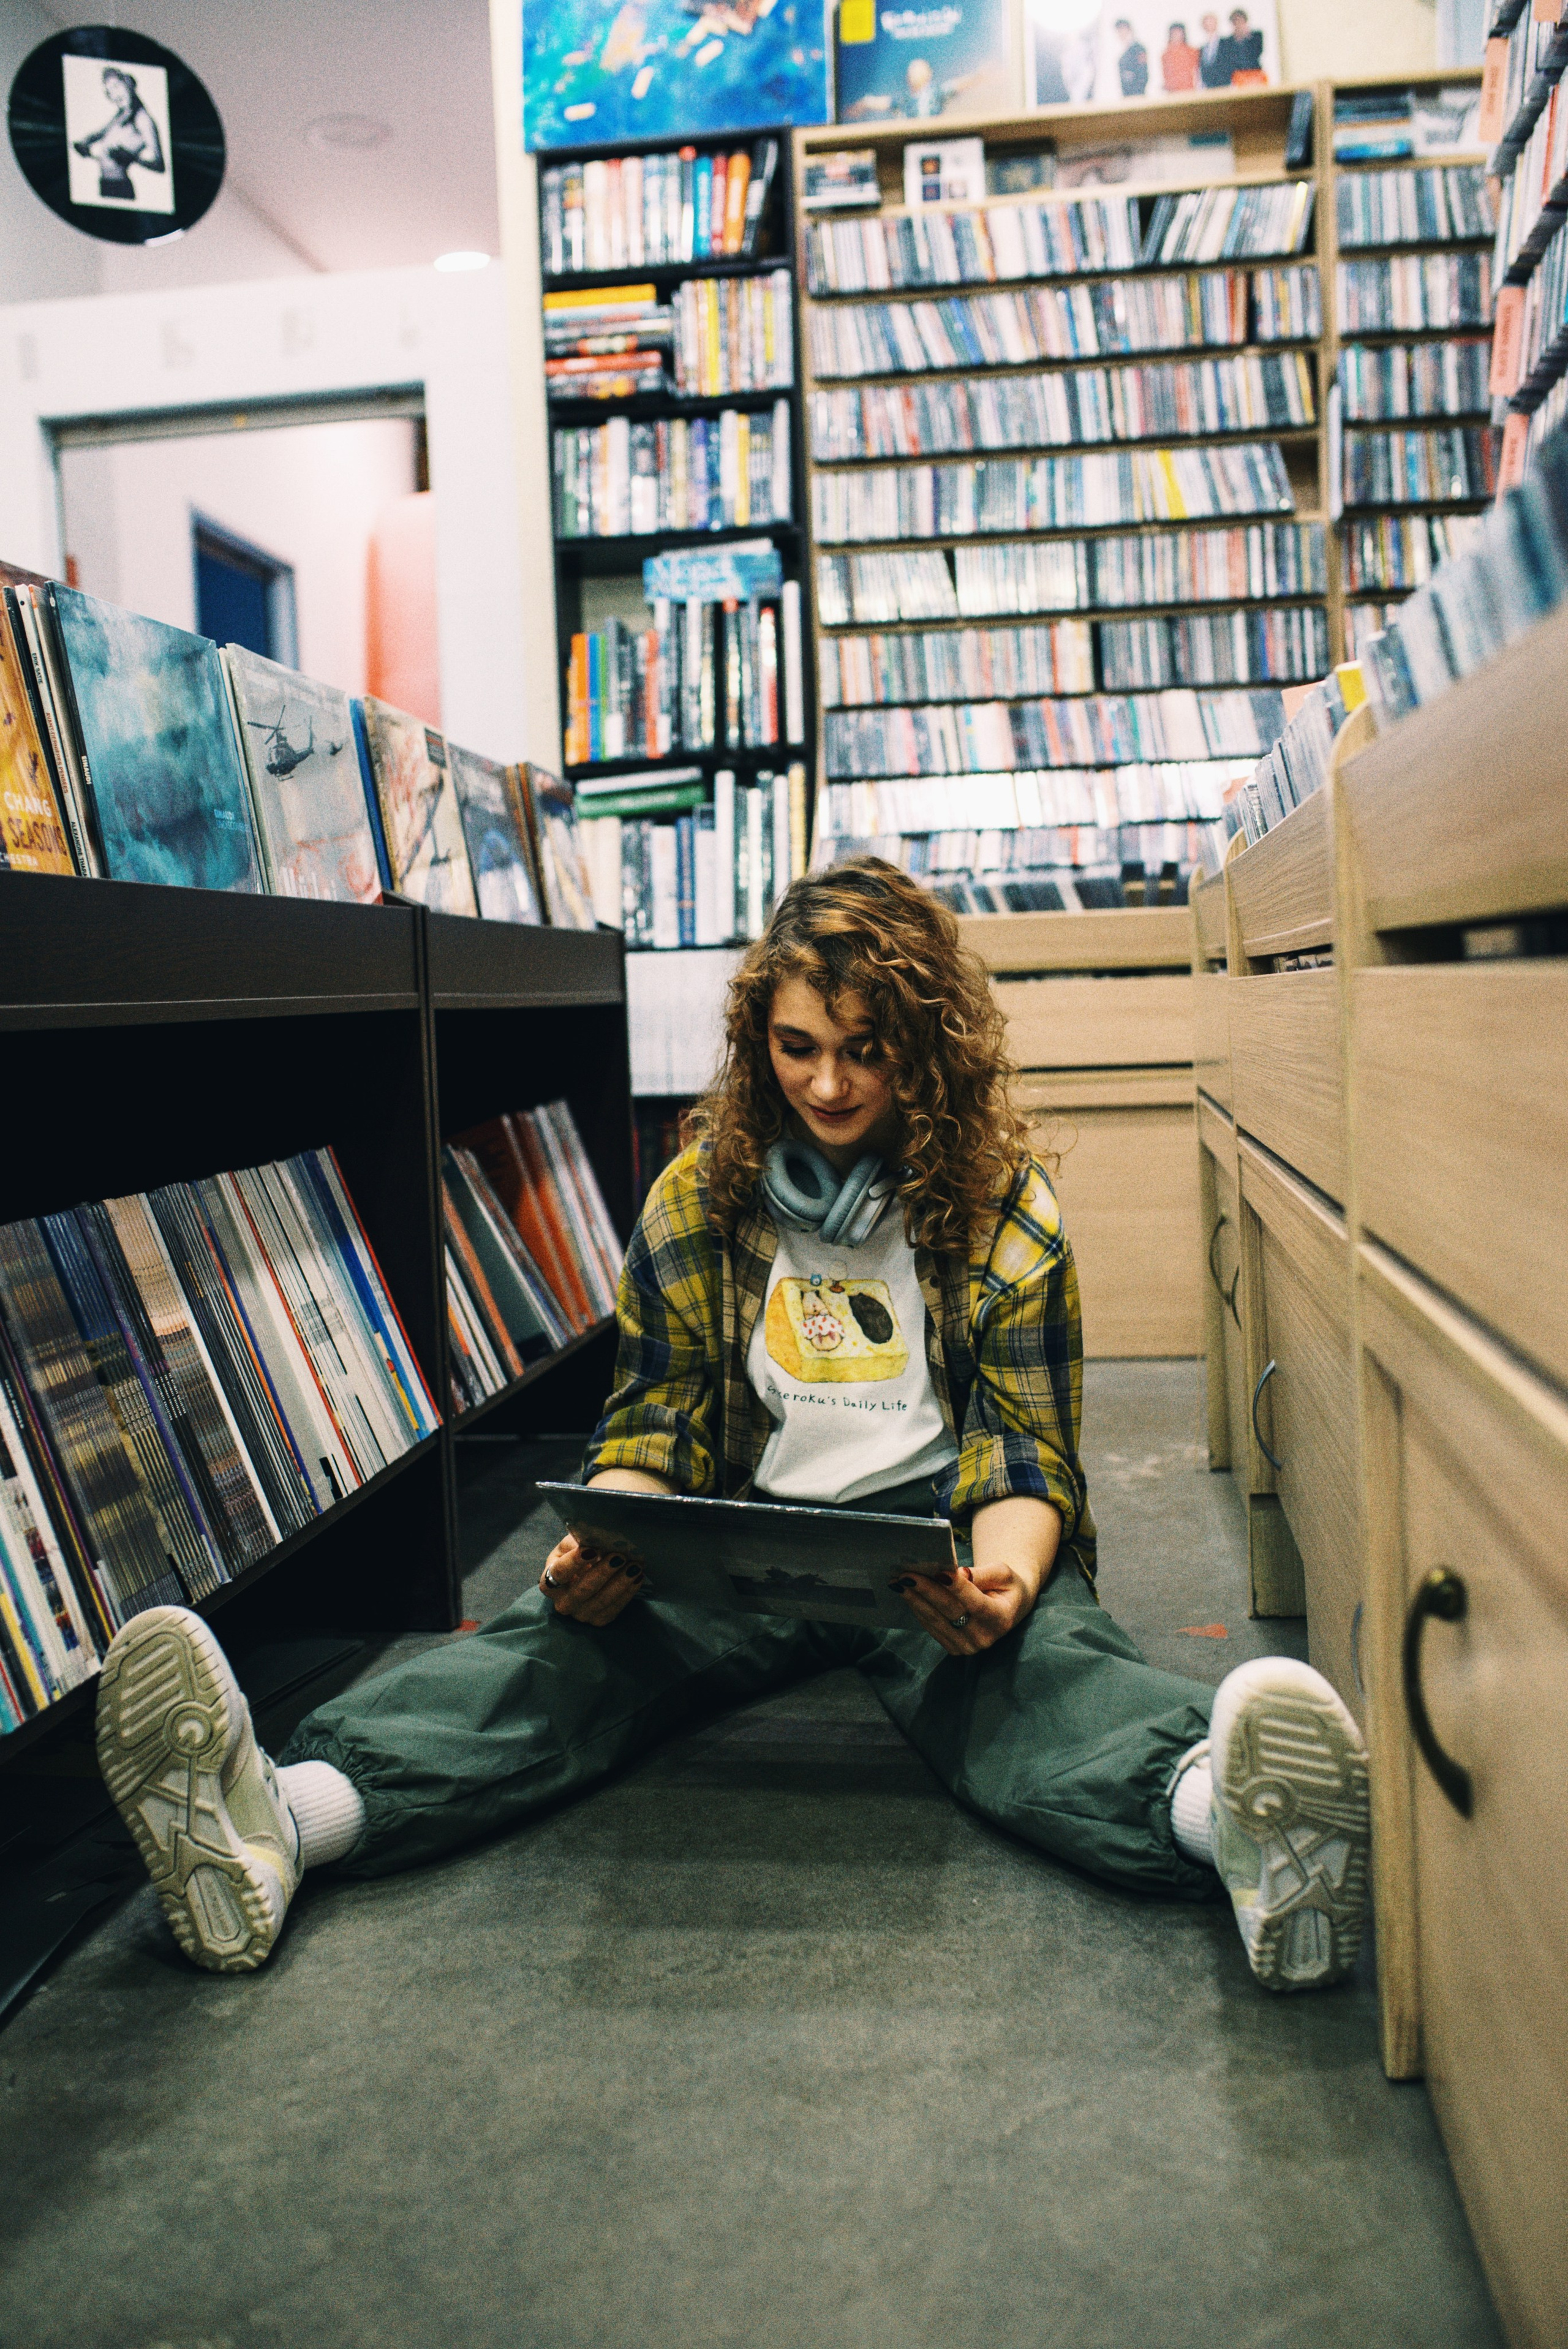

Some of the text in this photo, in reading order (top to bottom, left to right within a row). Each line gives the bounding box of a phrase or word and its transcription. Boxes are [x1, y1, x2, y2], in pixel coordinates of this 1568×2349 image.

[81, 755, 91, 785] EINAUDI
[4, 791, 52, 817] CHANG
[7, 816, 67, 856] SEASONS
[71, 821, 83, 856] ALEXANDRE
[843, 1397, 876, 1411] Daily
[882, 1400, 907, 1411] Life
